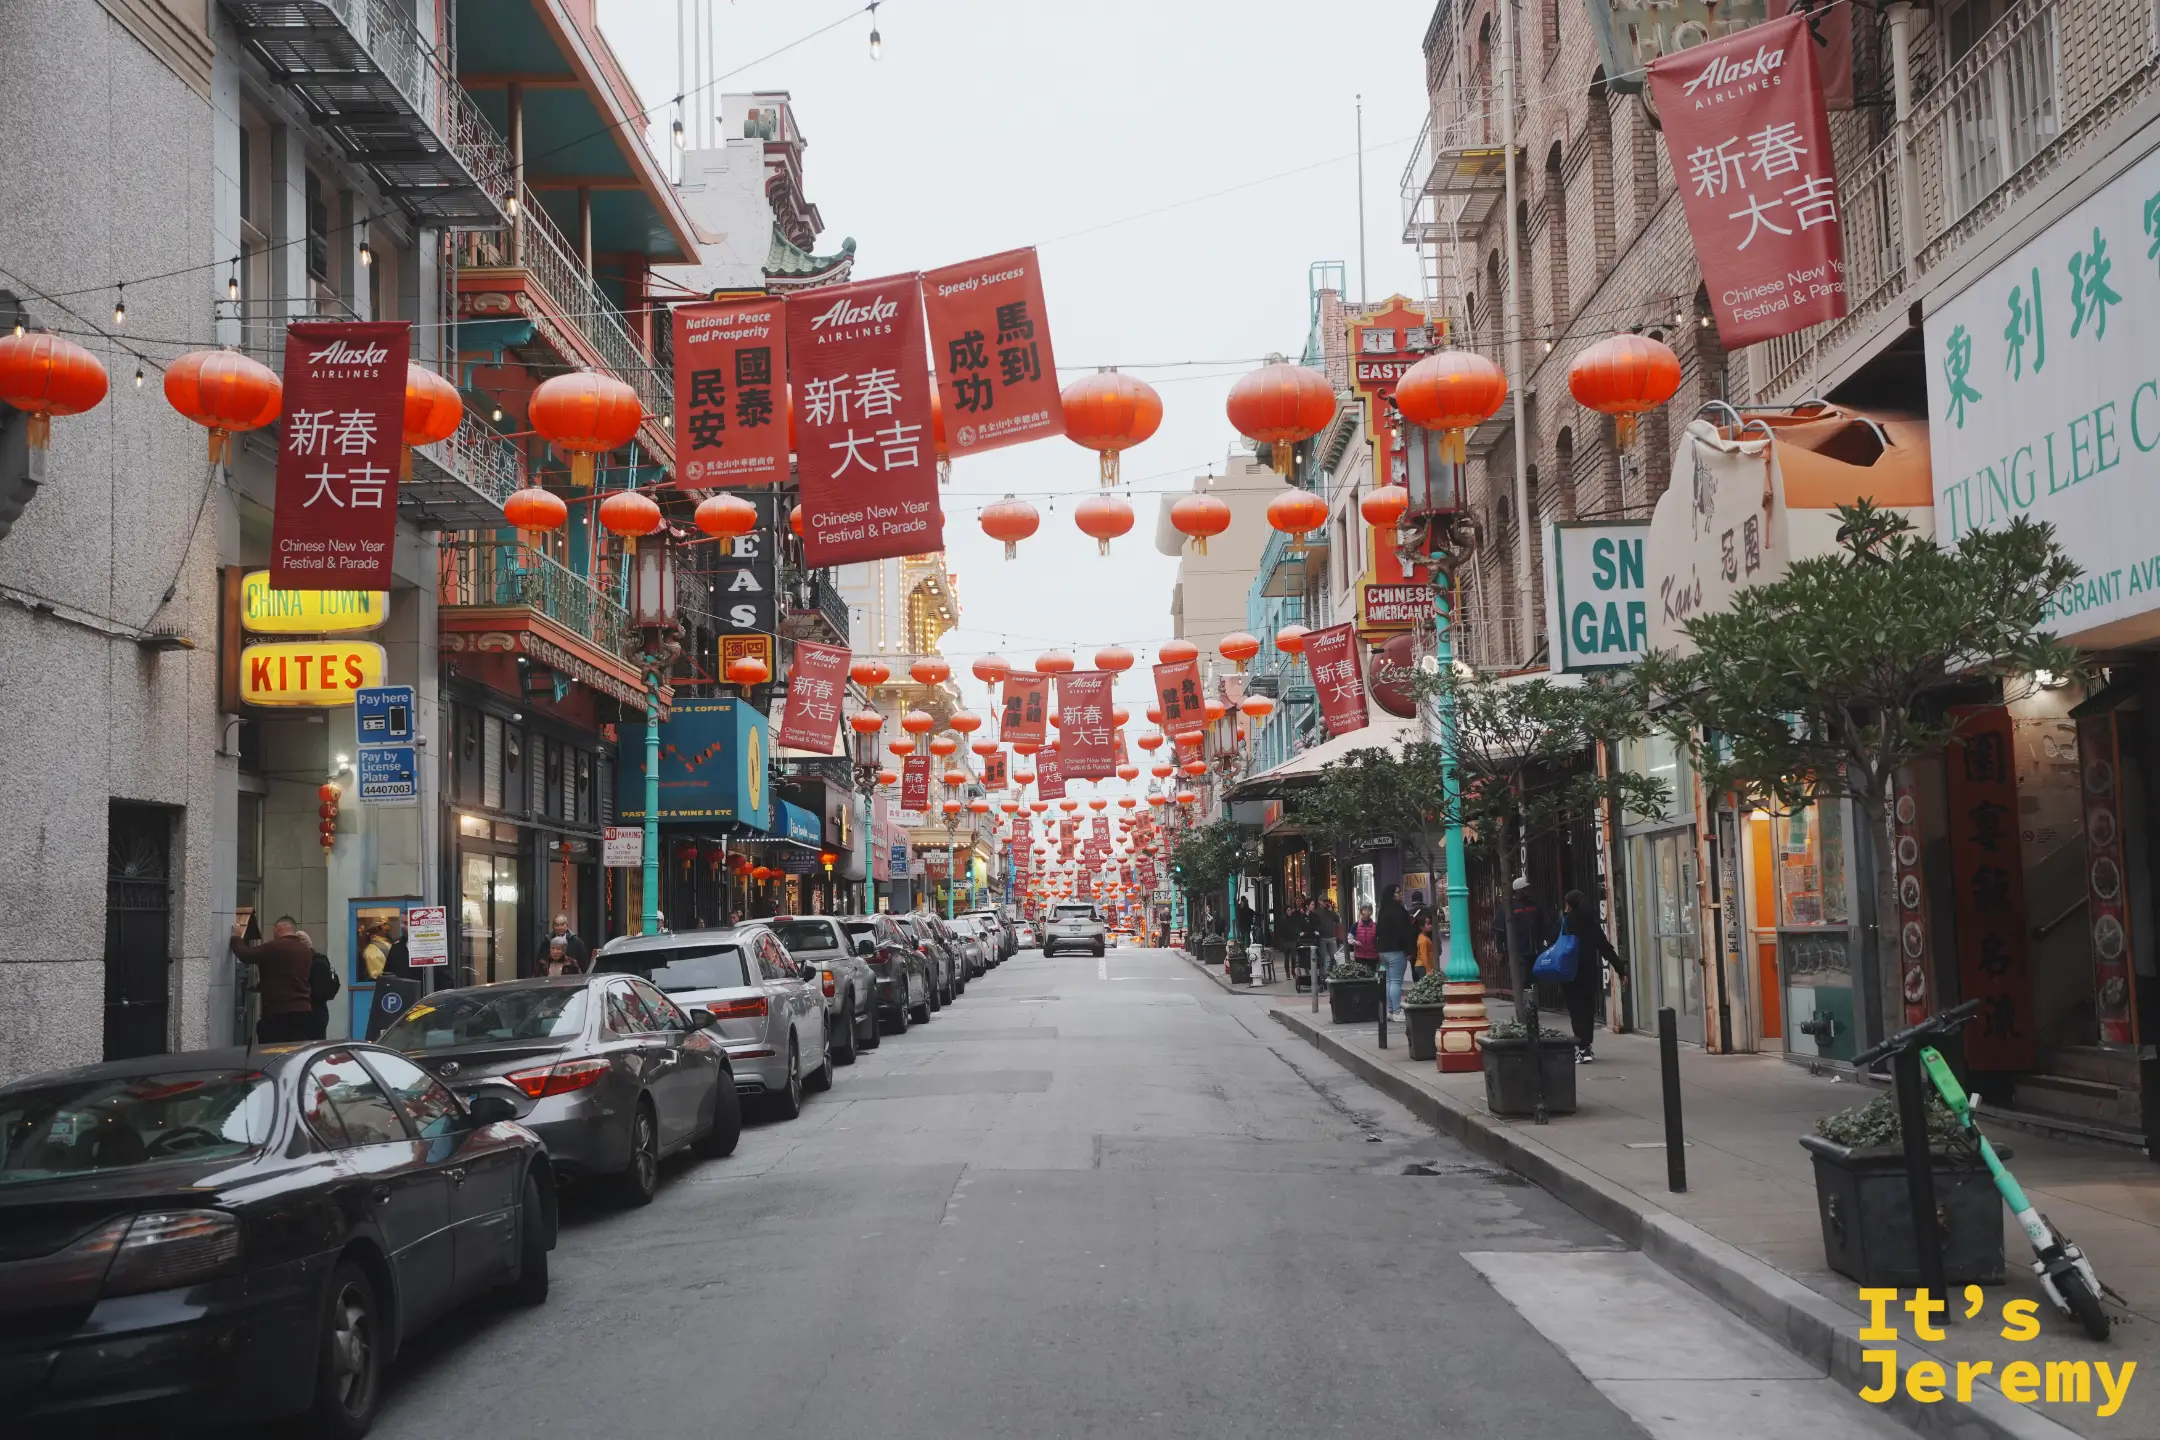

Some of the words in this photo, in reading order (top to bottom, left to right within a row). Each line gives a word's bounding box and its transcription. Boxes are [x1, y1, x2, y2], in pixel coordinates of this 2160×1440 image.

[1683, 45, 1785, 97] Alaska
[1694, 76, 1782, 110] AIRLINES
[1687, 121, 1808, 198] 新春
[1728, 174, 1837, 251] 大吉
[938, 276, 979, 298] Speedy
[981, 267, 1025, 286] Success
[1722, 281, 1785, 306] Chinese
[1787, 266, 1825, 288] New
[1828, 258, 1845, 273] Ye
[810, 295, 898, 331] Alaska
[1732, 298, 1790, 324] Festival
[1793, 290, 1807, 306] &
[1943, 191, 2160, 430] 東利珠
[686, 314, 735, 330] National
[738, 312, 771, 326] Peace
[688, 330, 710, 343] and
[711, 325, 769, 343] Prosperity
[817, 324, 892, 345] AIRLINES
[996, 300, 1041, 387] 馬到
[308, 340, 388, 367] Alaska
[311, 369, 379, 379] AIRLINES
[949, 330, 994, 413] 成功
[1358, 363, 1412, 379] EAST
[734, 346, 773, 429] 國泰
[804, 367, 903, 428] 新春
[688, 368, 726, 451] 民安
[289, 408, 378, 456] 新春
[829, 420, 922, 479] 大吉
[1943, 443, 2036, 543] TUNG
[2044, 400, 2120, 496] LEE
[302, 461, 390, 509] 大吉
[811, 509, 864, 529] Chinese
[866, 505, 897, 519] New
[899, 500, 930, 515] Year
[817, 525, 866, 545] Festival
[868, 523, 880, 537] &
[882, 518, 927, 536] Parade
[280, 539, 326, 552] Chinese
[329, 539, 357, 552] New
[360, 539, 386, 552] Year
[283, 556, 324, 569] Festival
[327, 557, 336, 569] &
[340, 557, 379, 569] Parade
[727, 501, 764, 628] EAS
[247, 583, 302, 619] CHINA
[319, 590, 370, 615] TOWN
[1367, 587, 1436, 604] CHINESE
[1660, 563, 1703, 625] Kan's
[2061, 569, 2122, 616] GRANT
[1369, 605, 1422, 621] AMERICAN
[1313, 632, 1346, 649] Alaska
[1317, 643, 1346, 653] AIRLINES
[804, 650, 841, 665] Alaska
[805, 660, 836, 670] AIRLINES
[251, 654, 364, 692] KITES
[1315, 659, 1355, 684] 新春
[793, 675, 834, 700] 新春
[1067, 677, 1102, 689] Alaska
[1330, 677, 1364, 703] 大吉
[359, 694, 381, 706] Pay
[382, 693, 408, 704] here
[694, 704, 732, 713] COFFEE
[797, 699, 837, 722] 大吉
[1063, 704, 1103, 726] 新春
[1329, 712, 1350, 722] Chinese
[785, 726, 806, 736] Chinese
[1333, 718, 1351, 728] Festival
[785, 734, 804, 742] Festival
[1072, 726, 1110, 747] 大吉
[361, 752, 381, 763] Pay
[384, 751, 398, 763] by
[362, 763, 401, 772] License
[362, 772, 389, 782] Plate
[904, 772, 924, 783] 新春
[1039, 762, 1058, 774] 新春
[1043, 772, 1062, 785] 大吉
[364, 784, 410, 794] 44407003
[907, 784, 926, 794] 大吉
[621, 810, 667, 818] PASTES
[605, 828, 616, 839] NO
[617, 831, 641, 839] PARKING
[1377, 836, 1390, 844] WAY
[387, 996, 398, 1010] P
